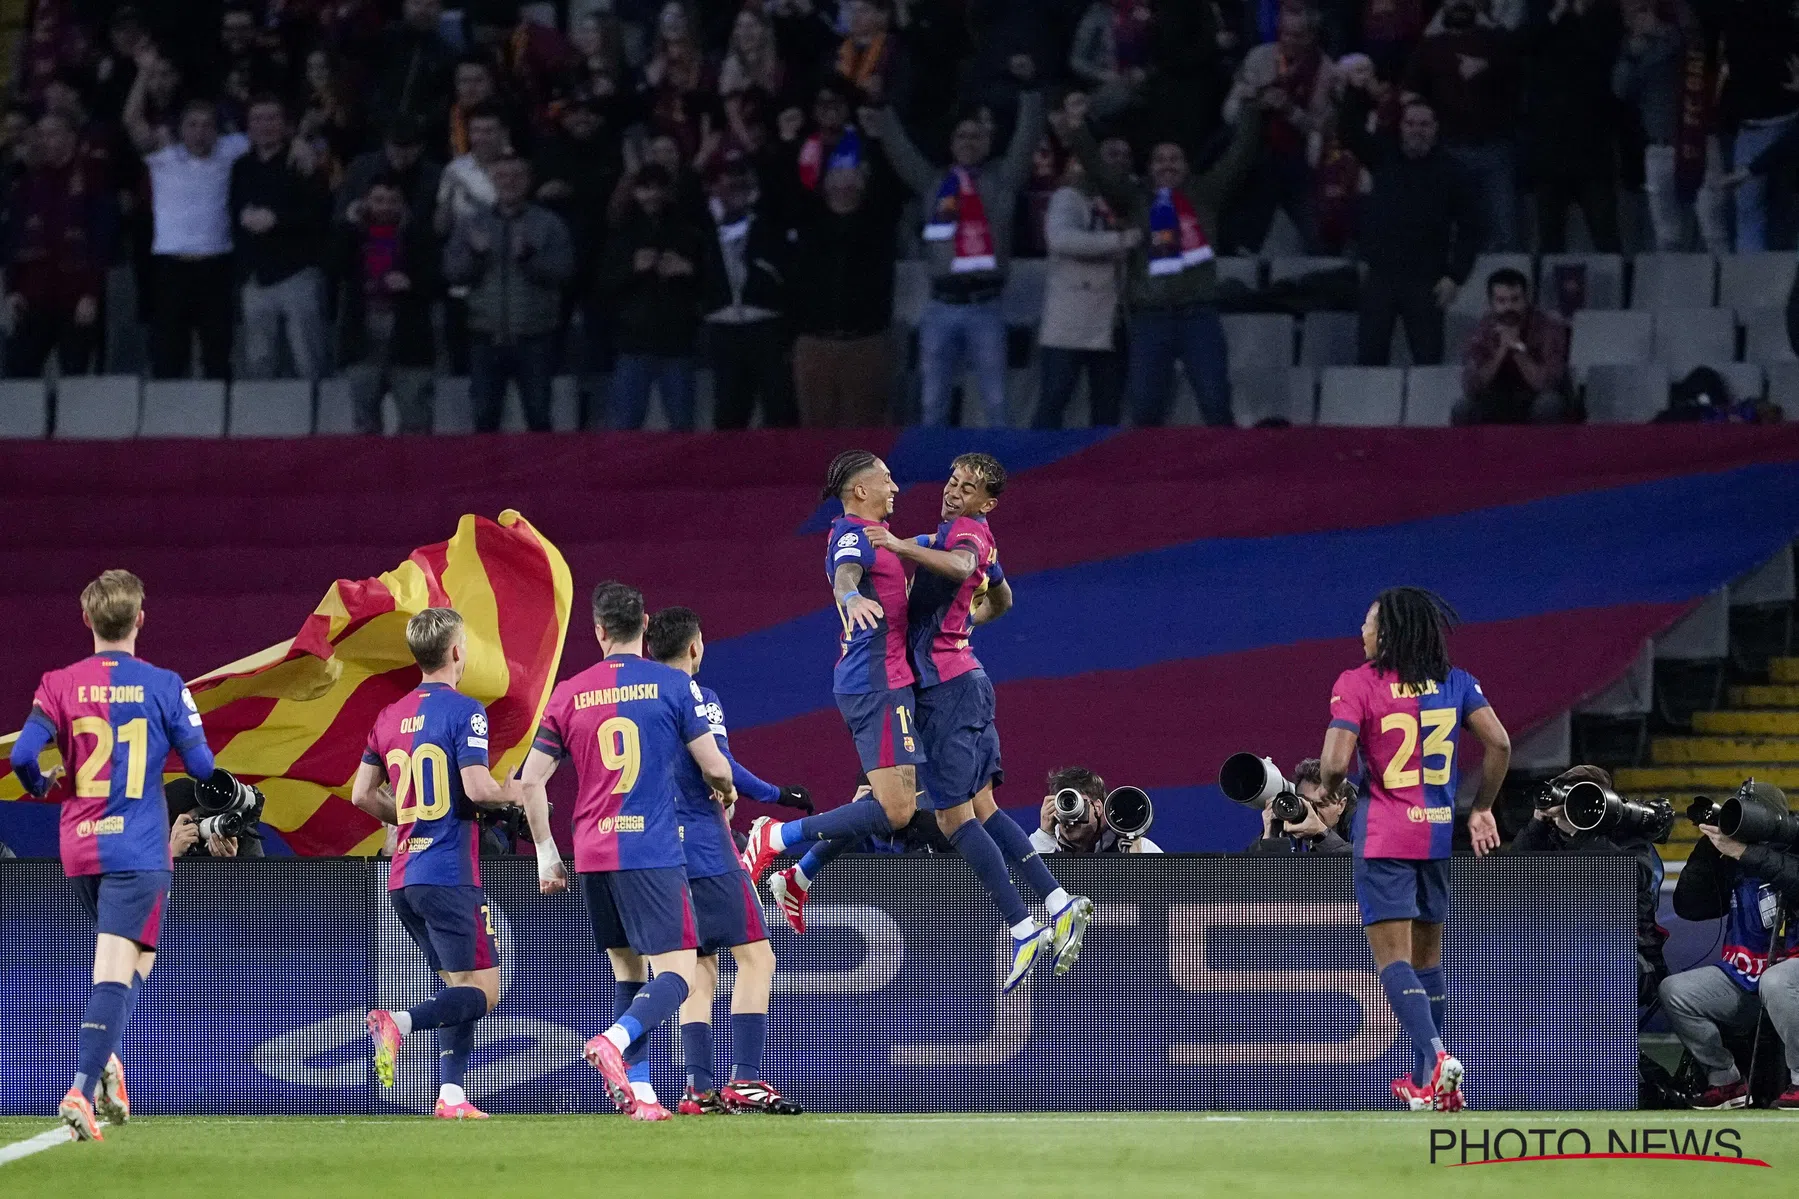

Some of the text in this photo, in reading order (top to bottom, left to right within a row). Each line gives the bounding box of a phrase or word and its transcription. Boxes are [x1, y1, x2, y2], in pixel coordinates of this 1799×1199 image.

[78, 685, 145, 703] F. DE JONG
[574, 683, 658, 710] LEWANDOWSKI
[400, 714, 425, 734] OLMO
[72, 716, 147, 799] 21
[597, 716, 640, 794] 9
[1381, 707, 1456, 789] 23
[386, 743, 450, 825] 20
[614, 822, 644, 830] ACNUR
[615, 815, 644, 823] UNHCR
[407, 837, 434, 845] UNHCR
[671, 902, 1397, 1066] PS5
